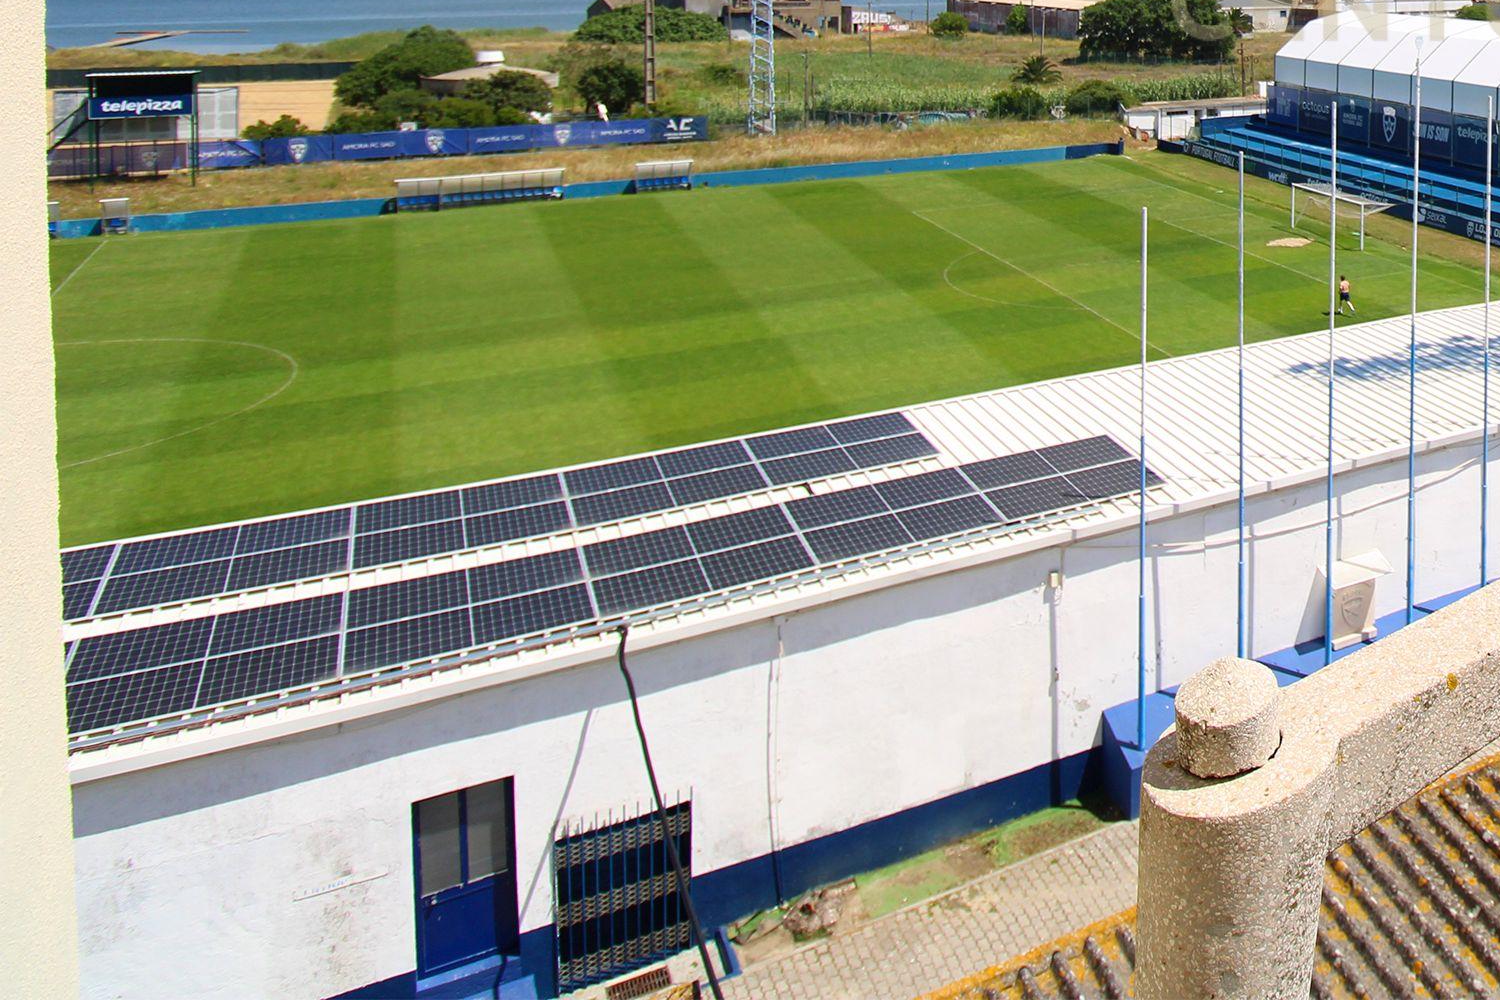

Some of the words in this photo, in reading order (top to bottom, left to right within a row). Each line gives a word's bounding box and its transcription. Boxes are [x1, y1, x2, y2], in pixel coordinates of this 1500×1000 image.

[101, 98, 183, 115] telepizza
[1302, 100, 1330, 114] octopus
[1457, 126, 1498, 145] telepiza
[1475, 223, 1492, 237] LOJ
